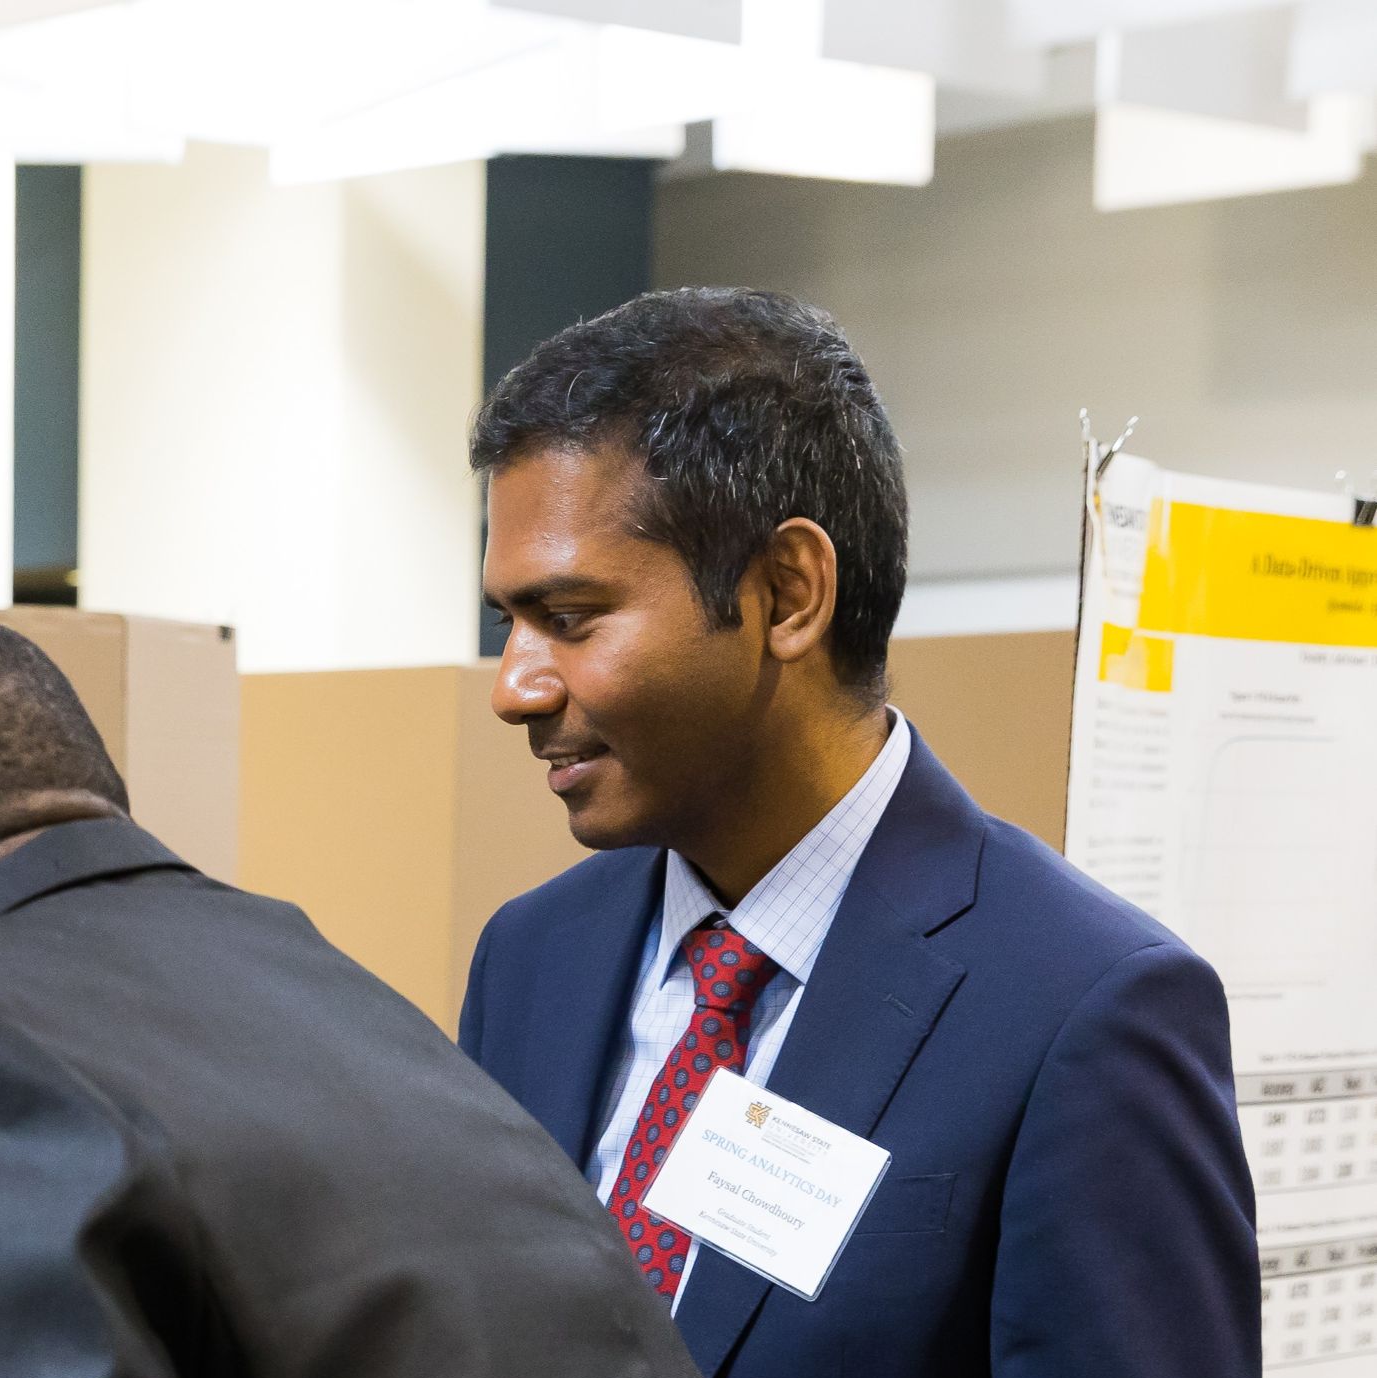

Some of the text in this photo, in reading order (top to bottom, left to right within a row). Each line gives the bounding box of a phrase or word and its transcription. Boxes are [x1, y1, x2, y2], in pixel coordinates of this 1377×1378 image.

[702, 1129, 747, 1160] SPRING
[747, 1154, 816, 1195] ANALYTICS
[817, 1189, 842, 1208] DAY
[707, 1171, 805, 1230] Faysal Chowdhoury
